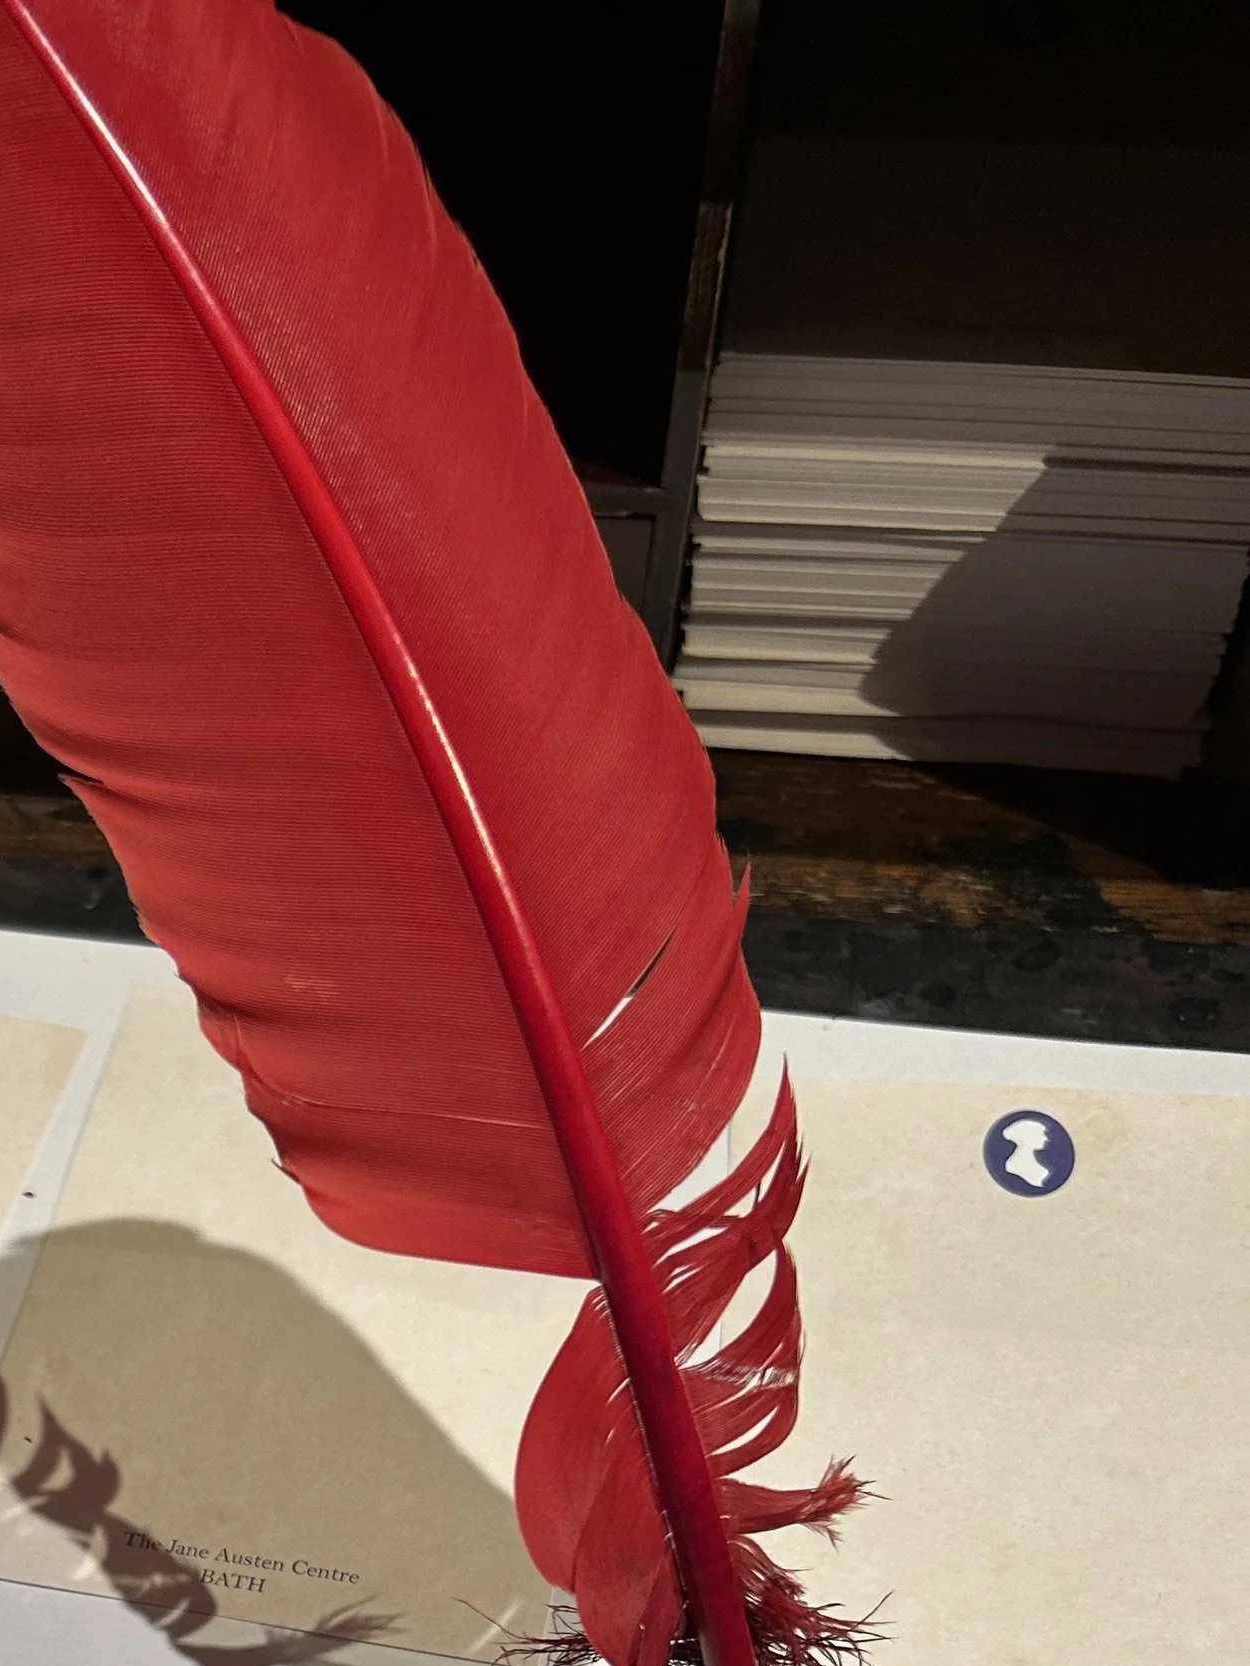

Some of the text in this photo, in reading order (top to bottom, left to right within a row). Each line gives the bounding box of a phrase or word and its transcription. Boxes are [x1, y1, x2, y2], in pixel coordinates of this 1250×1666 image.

[123, 1531, 361, 1584] The Jane Austen Centre
[199, 1568, 267, 1595] BATH
